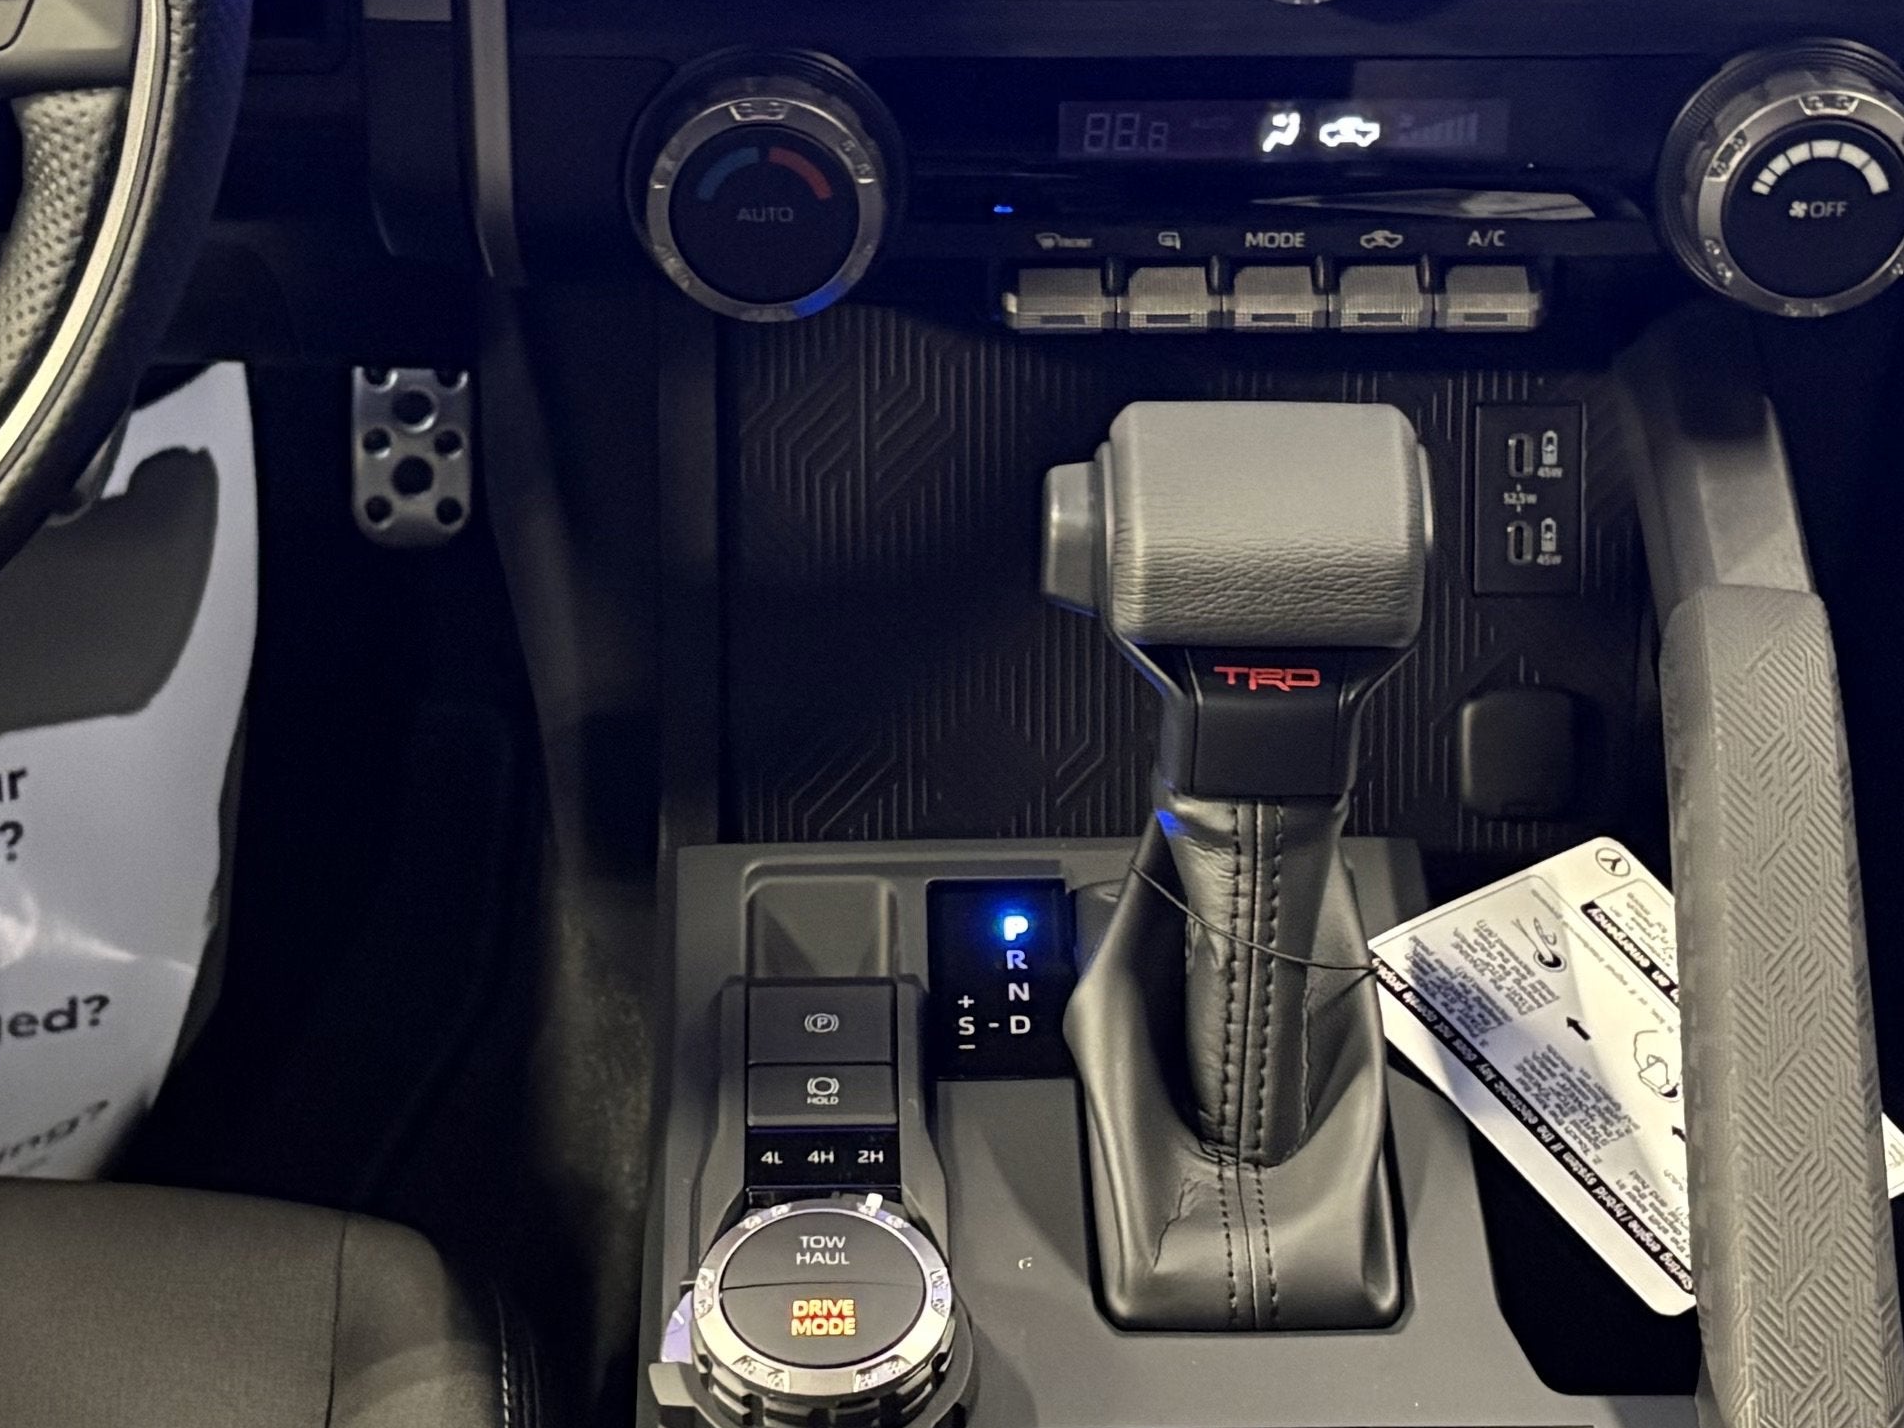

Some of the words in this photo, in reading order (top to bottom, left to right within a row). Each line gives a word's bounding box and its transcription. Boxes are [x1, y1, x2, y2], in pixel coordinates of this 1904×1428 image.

[737, 205, 795, 223] AUTO
[1809, 200, 1848, 220] OFF
[1245, 231, 1306, 248] MODE
[1467, 228, 1506, 249] A/C
[1213, 665, 1322, 692] TRD
[1003, 915, 1029, 941] P
[1585, 902, 1652, 971] emergency
[1006, 949, 1028, 970] R
[1649, 967, 1671, 989] an
[1008, 982, 1031, 1002] N
[958, 1016, 976, 1036] S
[1010, 1016, 1032, 1035] D
[1473, 1058, 1498, 1083] key
[806, 1095, 840, 1106] HOLD
[1534, 1123, 1555, 1144] the
[760, 1150, 784, 1165] 4L
[806, 1150, 836, 1165] 4H
[856, 1149, 885, 1164] 2H
[1560, 1147, 1599, 1187] system
[800, 1235, 847, 1249] TOW
[795, 1252, 851, 1265] HAUL
[1656, 1248, 1699, 1291] Starting
[791, 1298, 856, 1318] DRIVE
[790, 1318, 857, 1337] MODE
